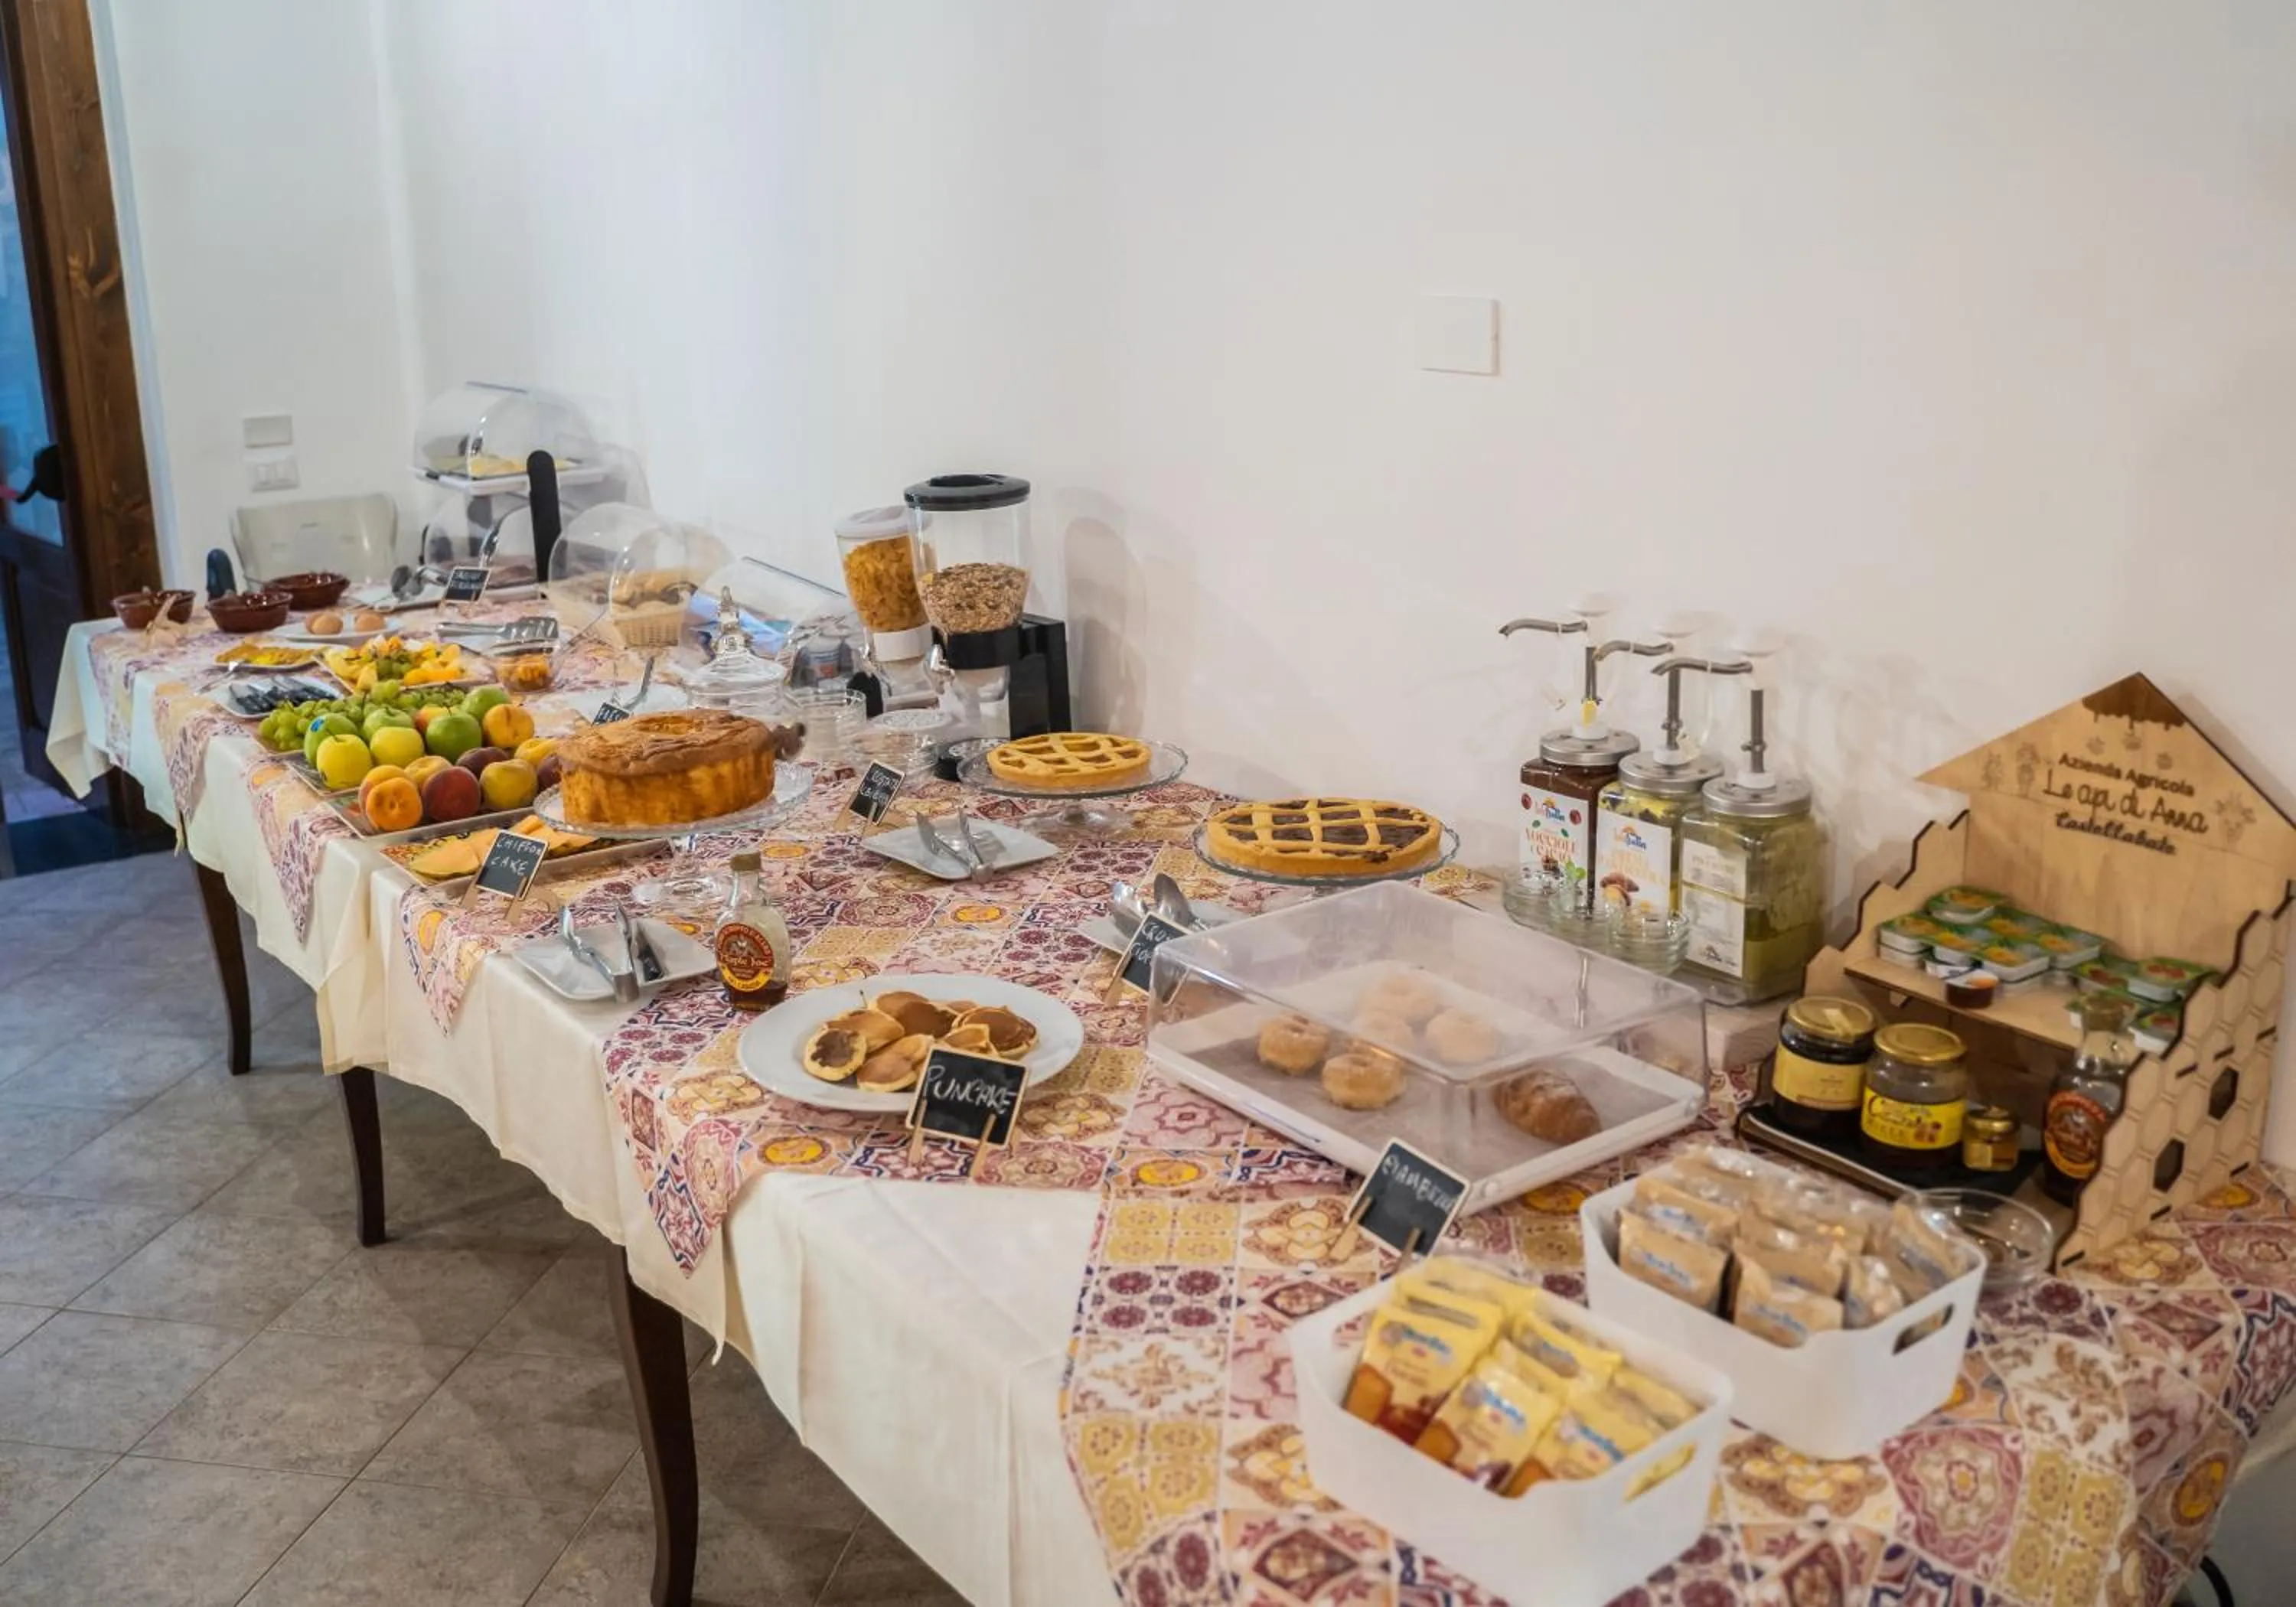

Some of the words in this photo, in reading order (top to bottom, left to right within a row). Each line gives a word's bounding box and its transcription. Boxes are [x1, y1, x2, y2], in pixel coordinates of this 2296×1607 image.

[2059, 753, 2122, 780] Azienda
[2125, 768, 2195, 797] Agricola
[2043, 769, 2073, 800] Le
[2150, 796, 2210, 833] Anna
[491, 856, 529, 876] CAKE
